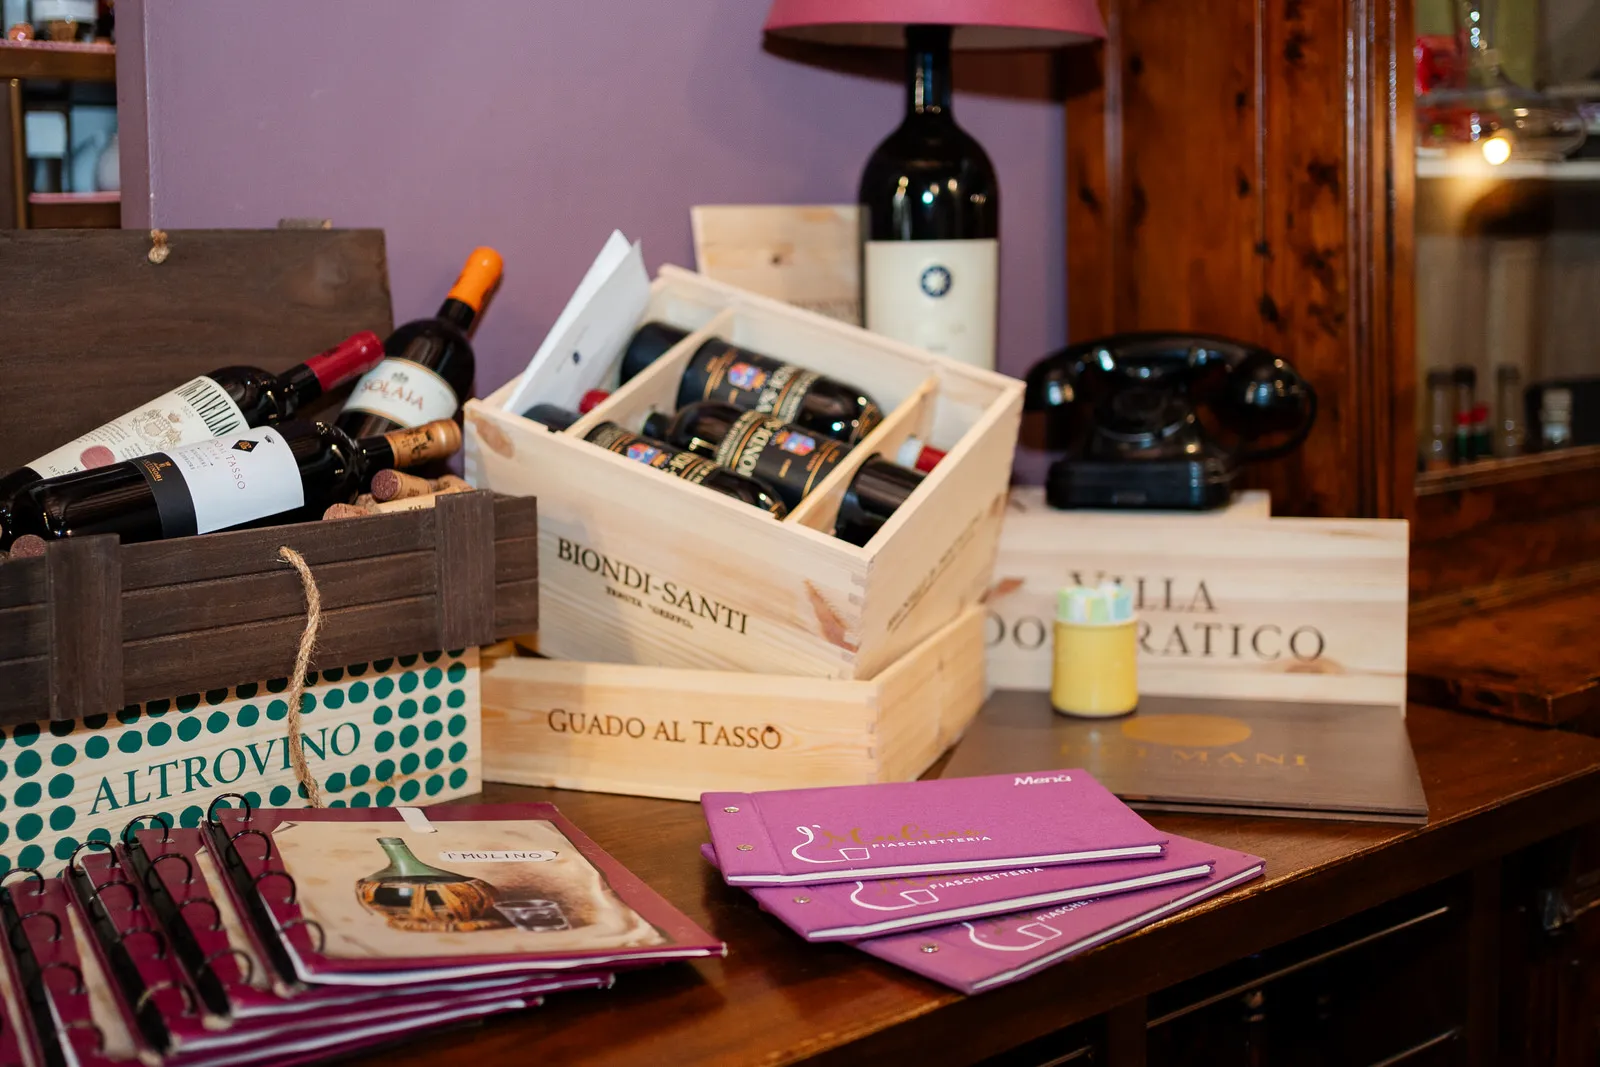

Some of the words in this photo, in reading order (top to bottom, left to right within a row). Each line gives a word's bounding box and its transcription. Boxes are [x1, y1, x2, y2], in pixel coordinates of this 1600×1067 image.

[225, 454, 246, 490] TASSO
[557, 537, 749, 635] BIONDI-SANTI
[985, 609, 1326, 663] DORATICO
[547, 708, 646, 739] GUADO
[653, 720, 687, 743] AL
[692, 719, 783, 750] TASSO
[87, 721, 362, 816] ALTROVINO
[460, 852, 543, 860] MULINO
[871, 835, 993, 849] FIASCHETTERIA
[928, 866, 1044, 890] FIASCHETTERIA
